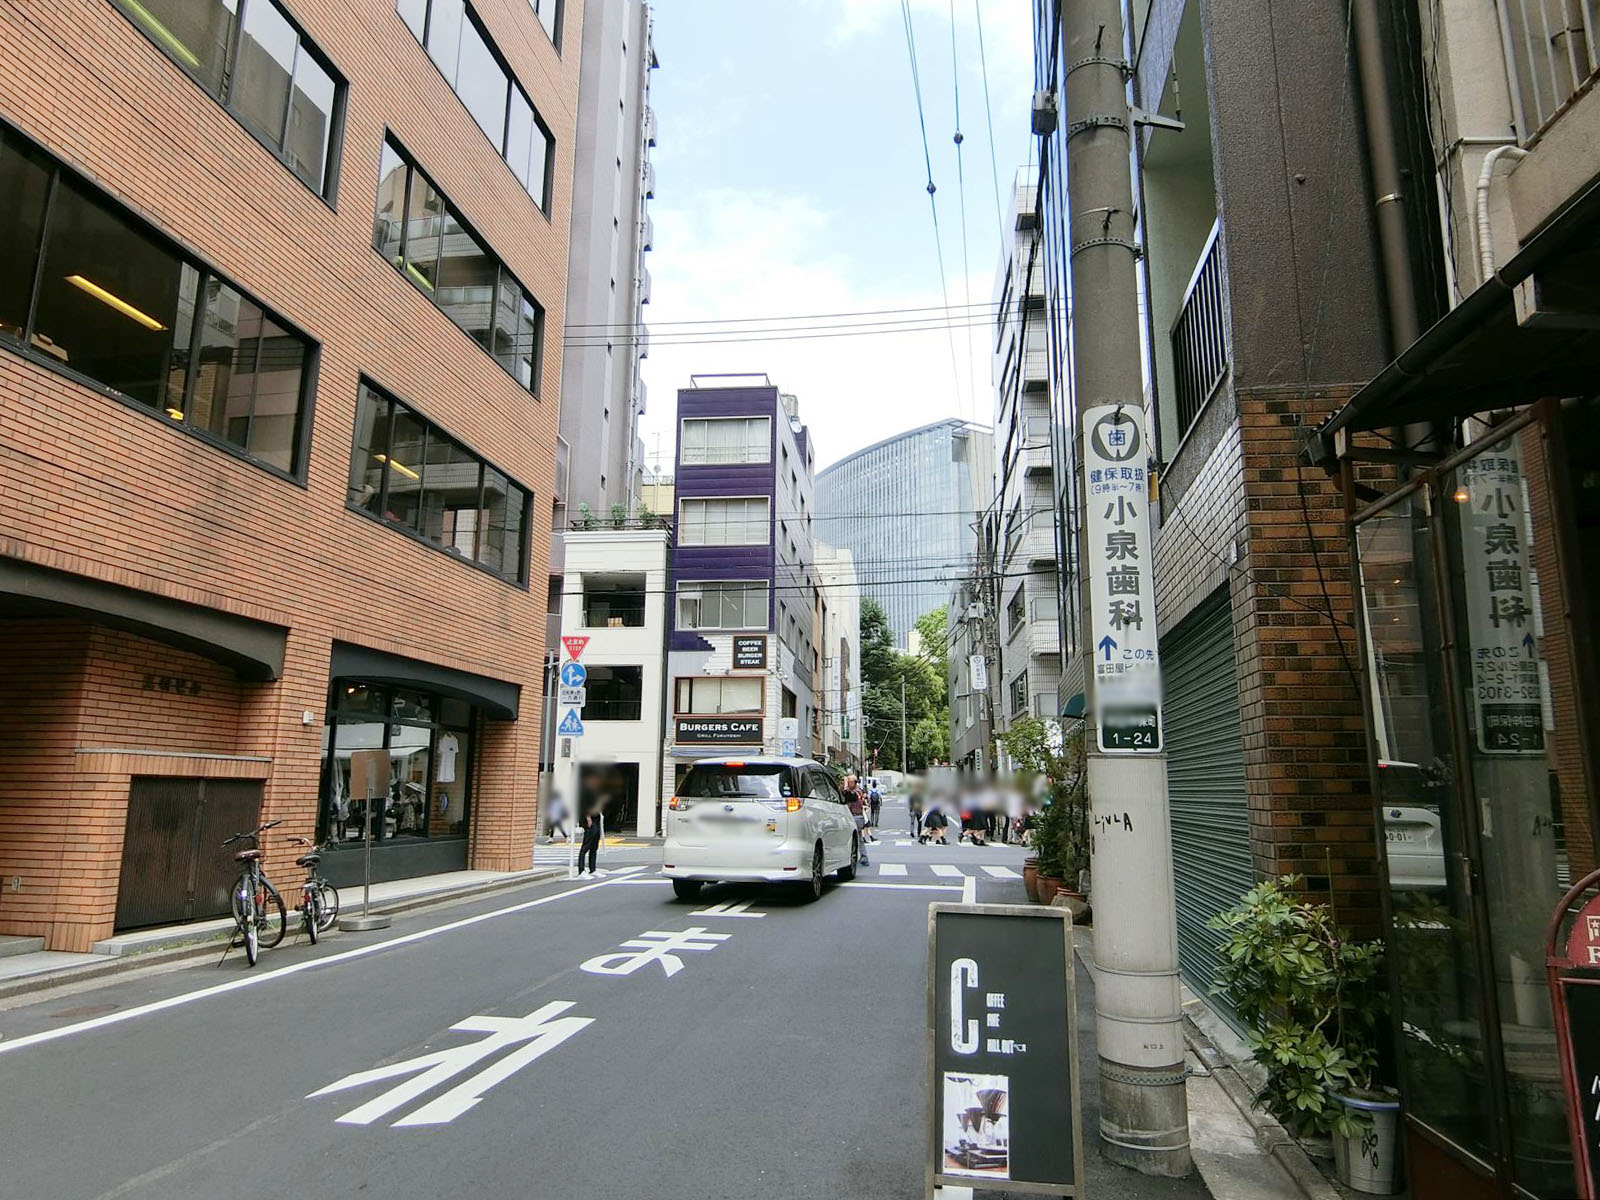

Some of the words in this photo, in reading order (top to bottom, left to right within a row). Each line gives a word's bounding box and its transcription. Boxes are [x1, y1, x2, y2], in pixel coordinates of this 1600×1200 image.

[1108, 429, 1126, 446] 歯
[1090, 467, 1145, 483] 健保取扱
[1104, 495, 1143, 631] 小泉歯科
[1123, 649, 1154, 661] この先
[680, 723, 728, 731] BURGERS
[731, 723, 758, 731] CAFE
[1112, 732, 1152, 745] 1-24
